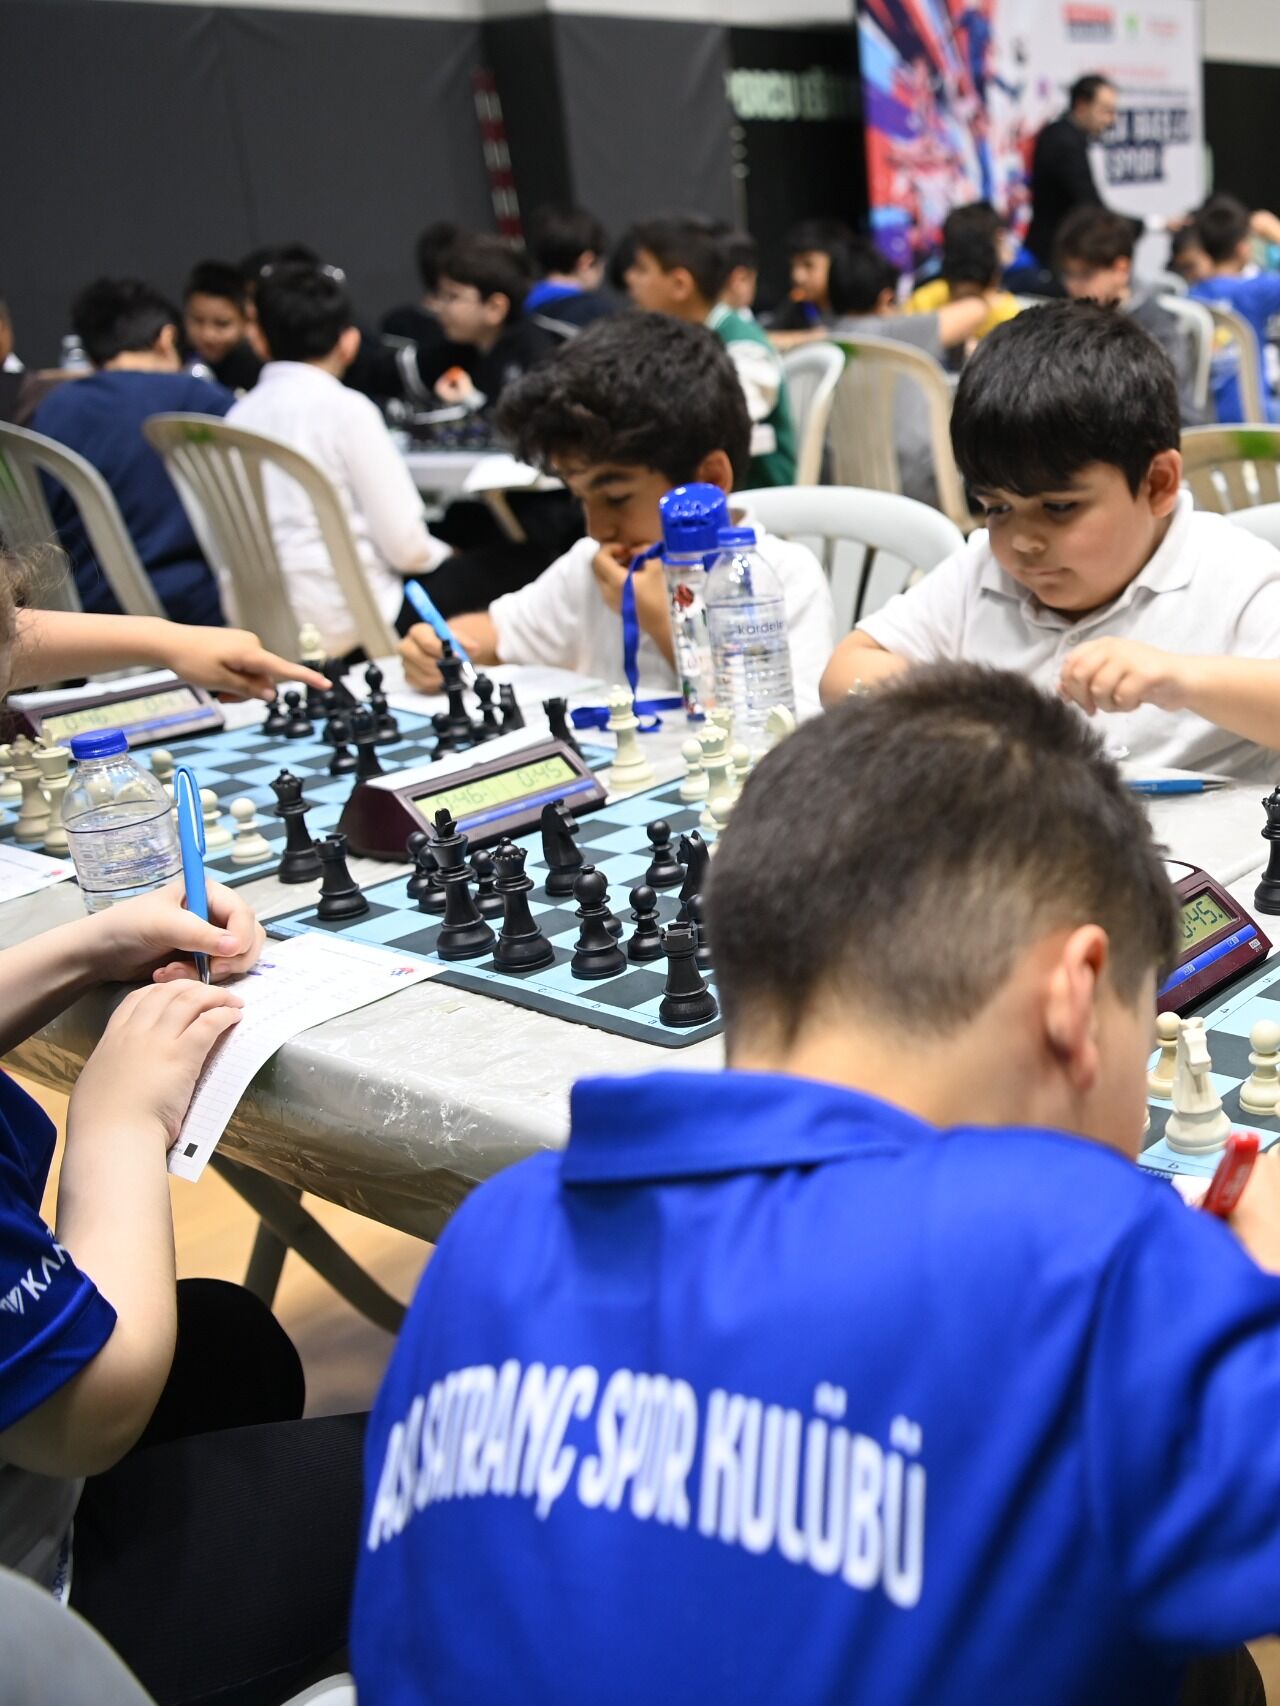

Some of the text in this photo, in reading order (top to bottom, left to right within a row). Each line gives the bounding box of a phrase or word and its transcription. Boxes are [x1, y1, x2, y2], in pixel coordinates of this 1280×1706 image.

[413, 1357, 599, 1521] SATRANÇ
[577, 1367, 698, 1531] SPOR
[698, 1380, 927, 1610] KULÜBÜ
